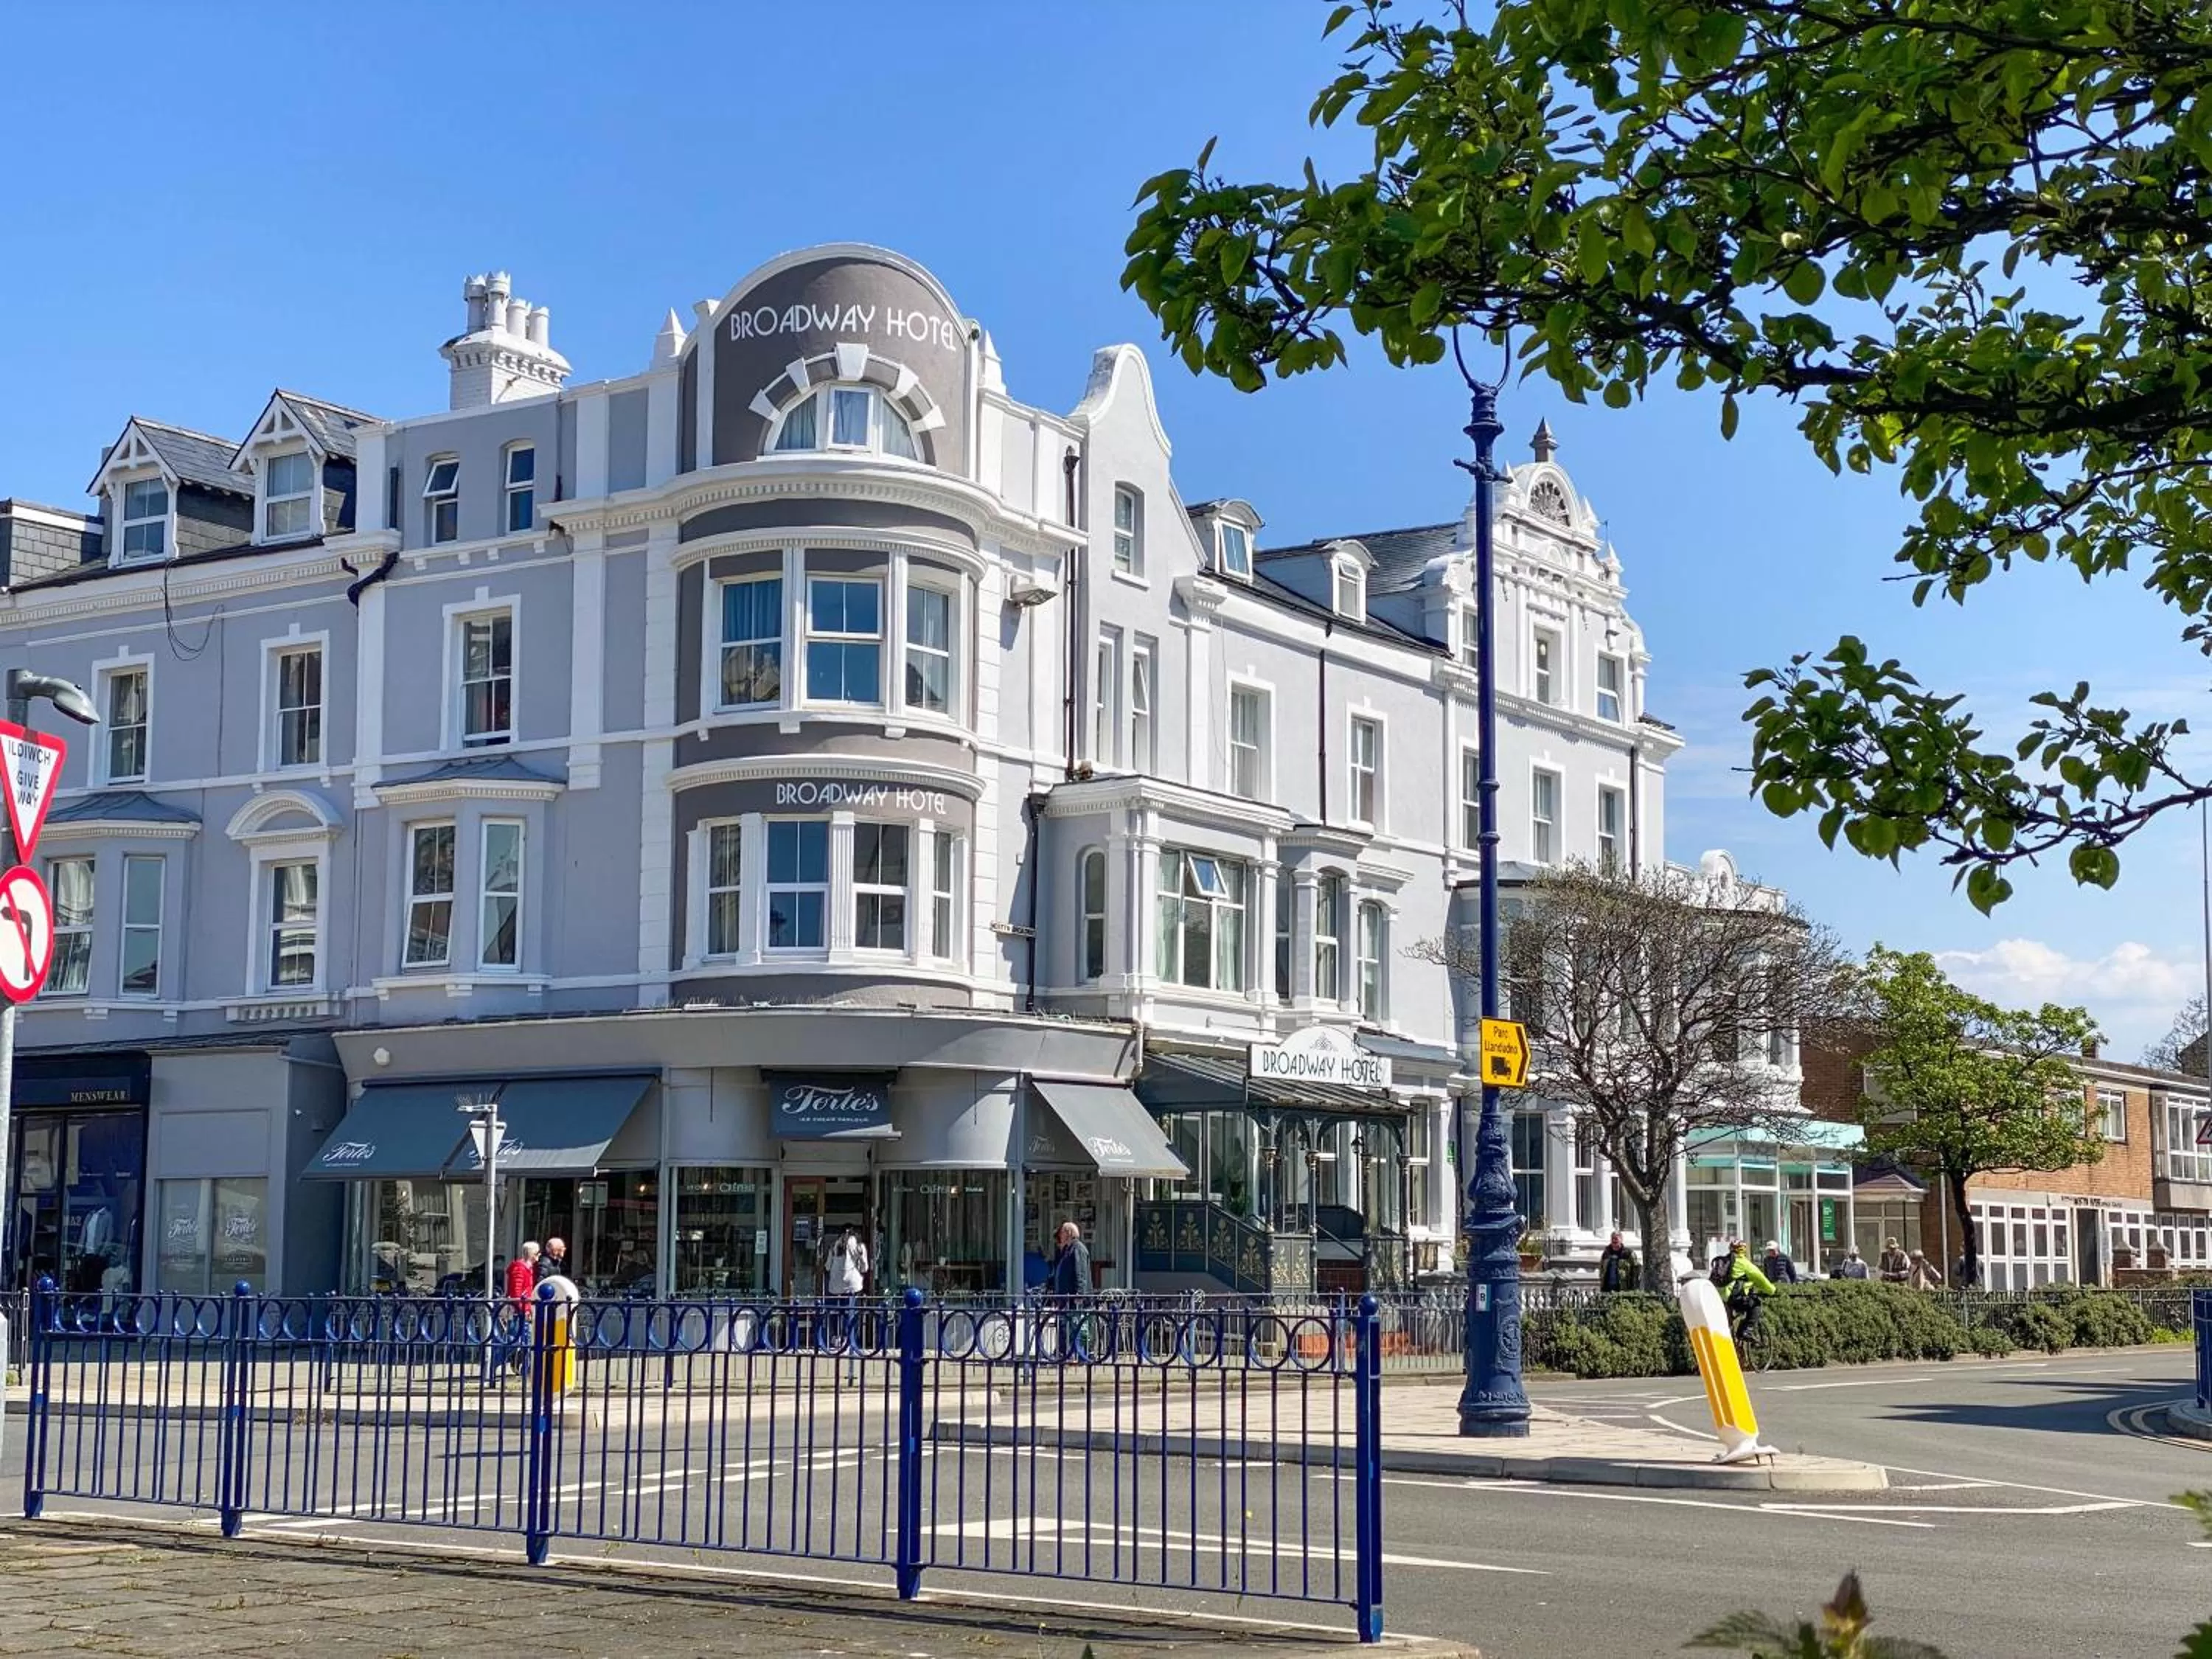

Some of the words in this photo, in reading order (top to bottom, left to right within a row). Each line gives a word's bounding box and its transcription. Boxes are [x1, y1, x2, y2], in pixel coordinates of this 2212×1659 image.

[731, 303, 876, 341] BROADWAY
[886, 307, 956, 351] HOTEL
[8, 740, 51, 765] ILDIWCH
[17, 771, 39, 790] GIVE
[17, 790, 39, 807] WAY
[776, 782, 888, 807] BROADWAY
[896, 787, 946, 814] HOTEL
[1263, 1050, 1335, 1078] BROADWAY
[1341, 1057, 1381, 1083] HOTEL
